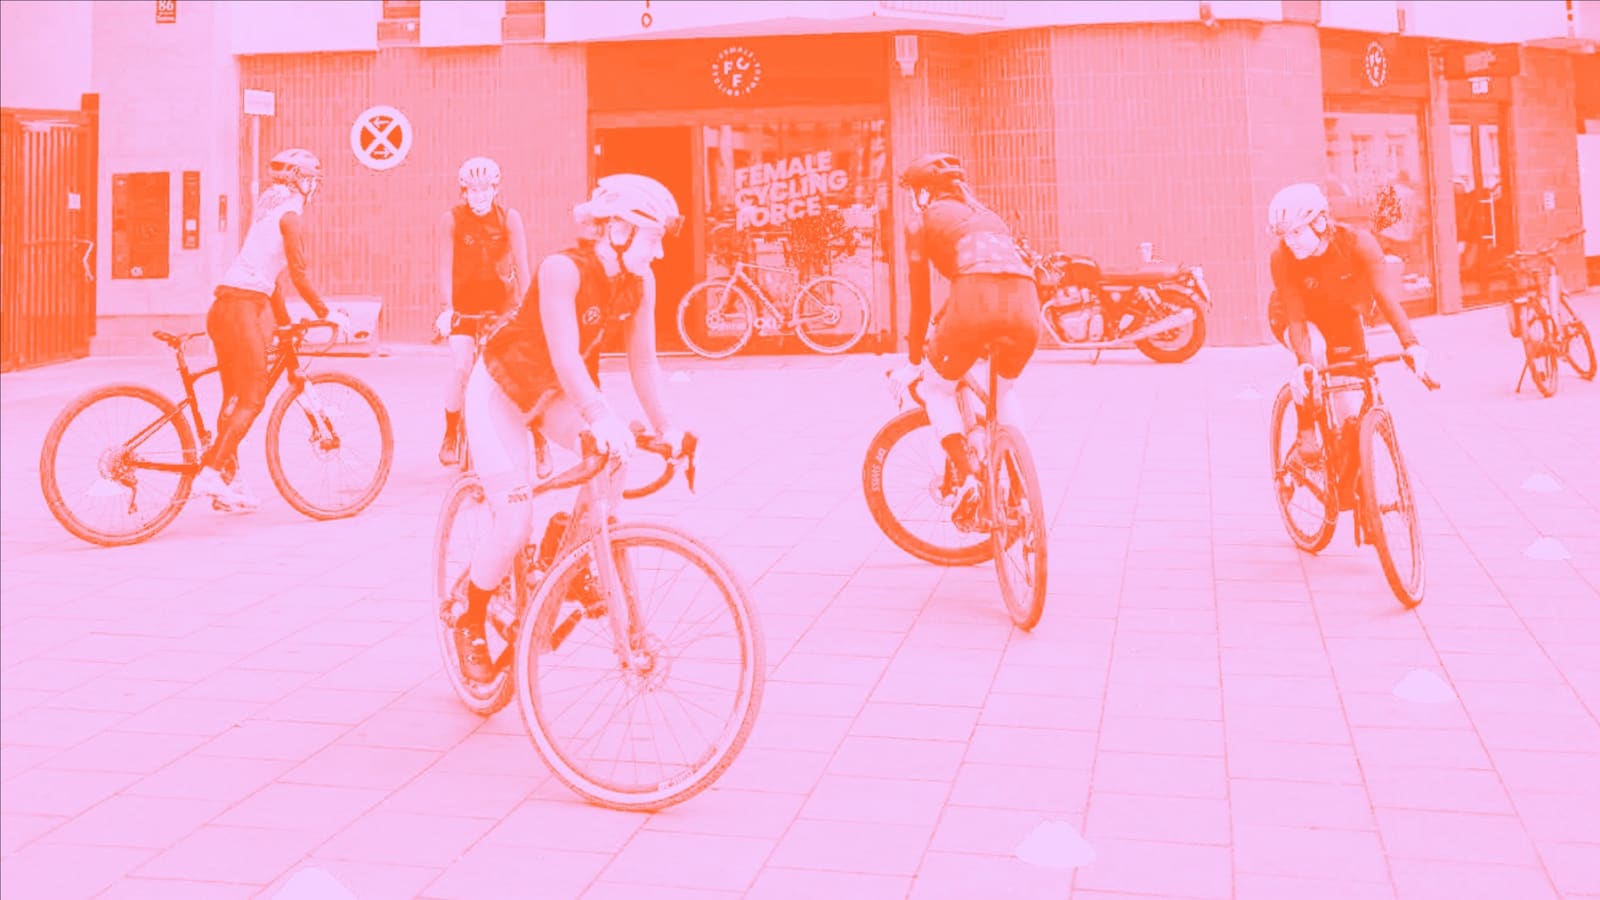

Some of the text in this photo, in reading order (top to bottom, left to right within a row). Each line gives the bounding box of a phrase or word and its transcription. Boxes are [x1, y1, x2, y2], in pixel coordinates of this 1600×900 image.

[735, 150, 833, 188] FEMALE
[735, 169, 848, 209] CYCLING
[736, 195, 821, 232] FORCE
